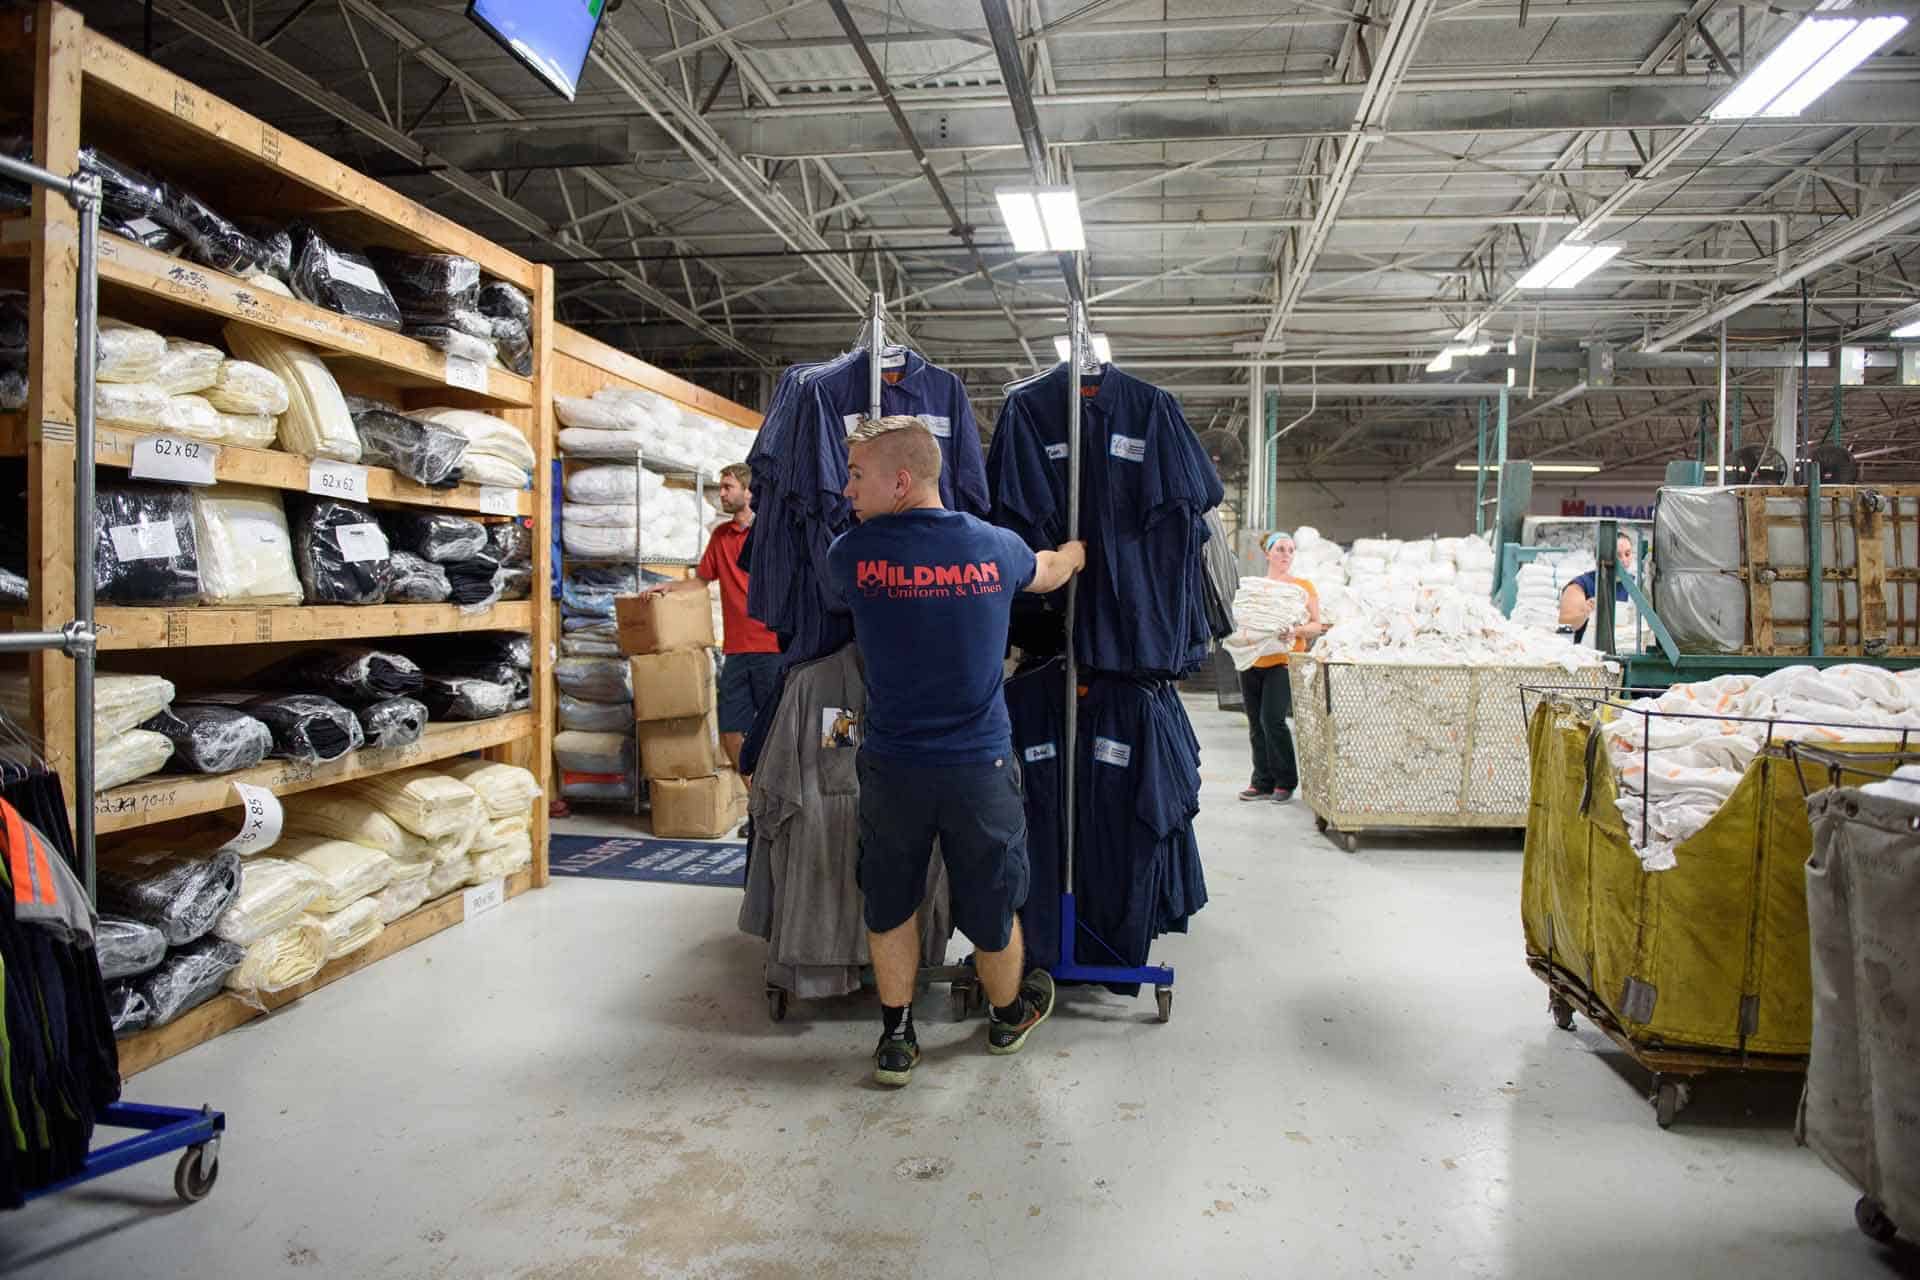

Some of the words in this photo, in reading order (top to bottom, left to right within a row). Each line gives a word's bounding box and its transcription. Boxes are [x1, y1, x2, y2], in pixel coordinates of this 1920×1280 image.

[155, 439, 170, 456] 62
[174, 446, 182, 457] x
[184, 442, 200, 458] 62
[322, 474, 334, 487] 62
[335, 480, 342, 489] x
[343, 478, 354, 491] 62
[857, 560, 1000, 588] WILDMAN
[888, 585, 950, 598] Uniform
[955, 583, 967, 597] &
[971, 583, 1002, 595] Linen
